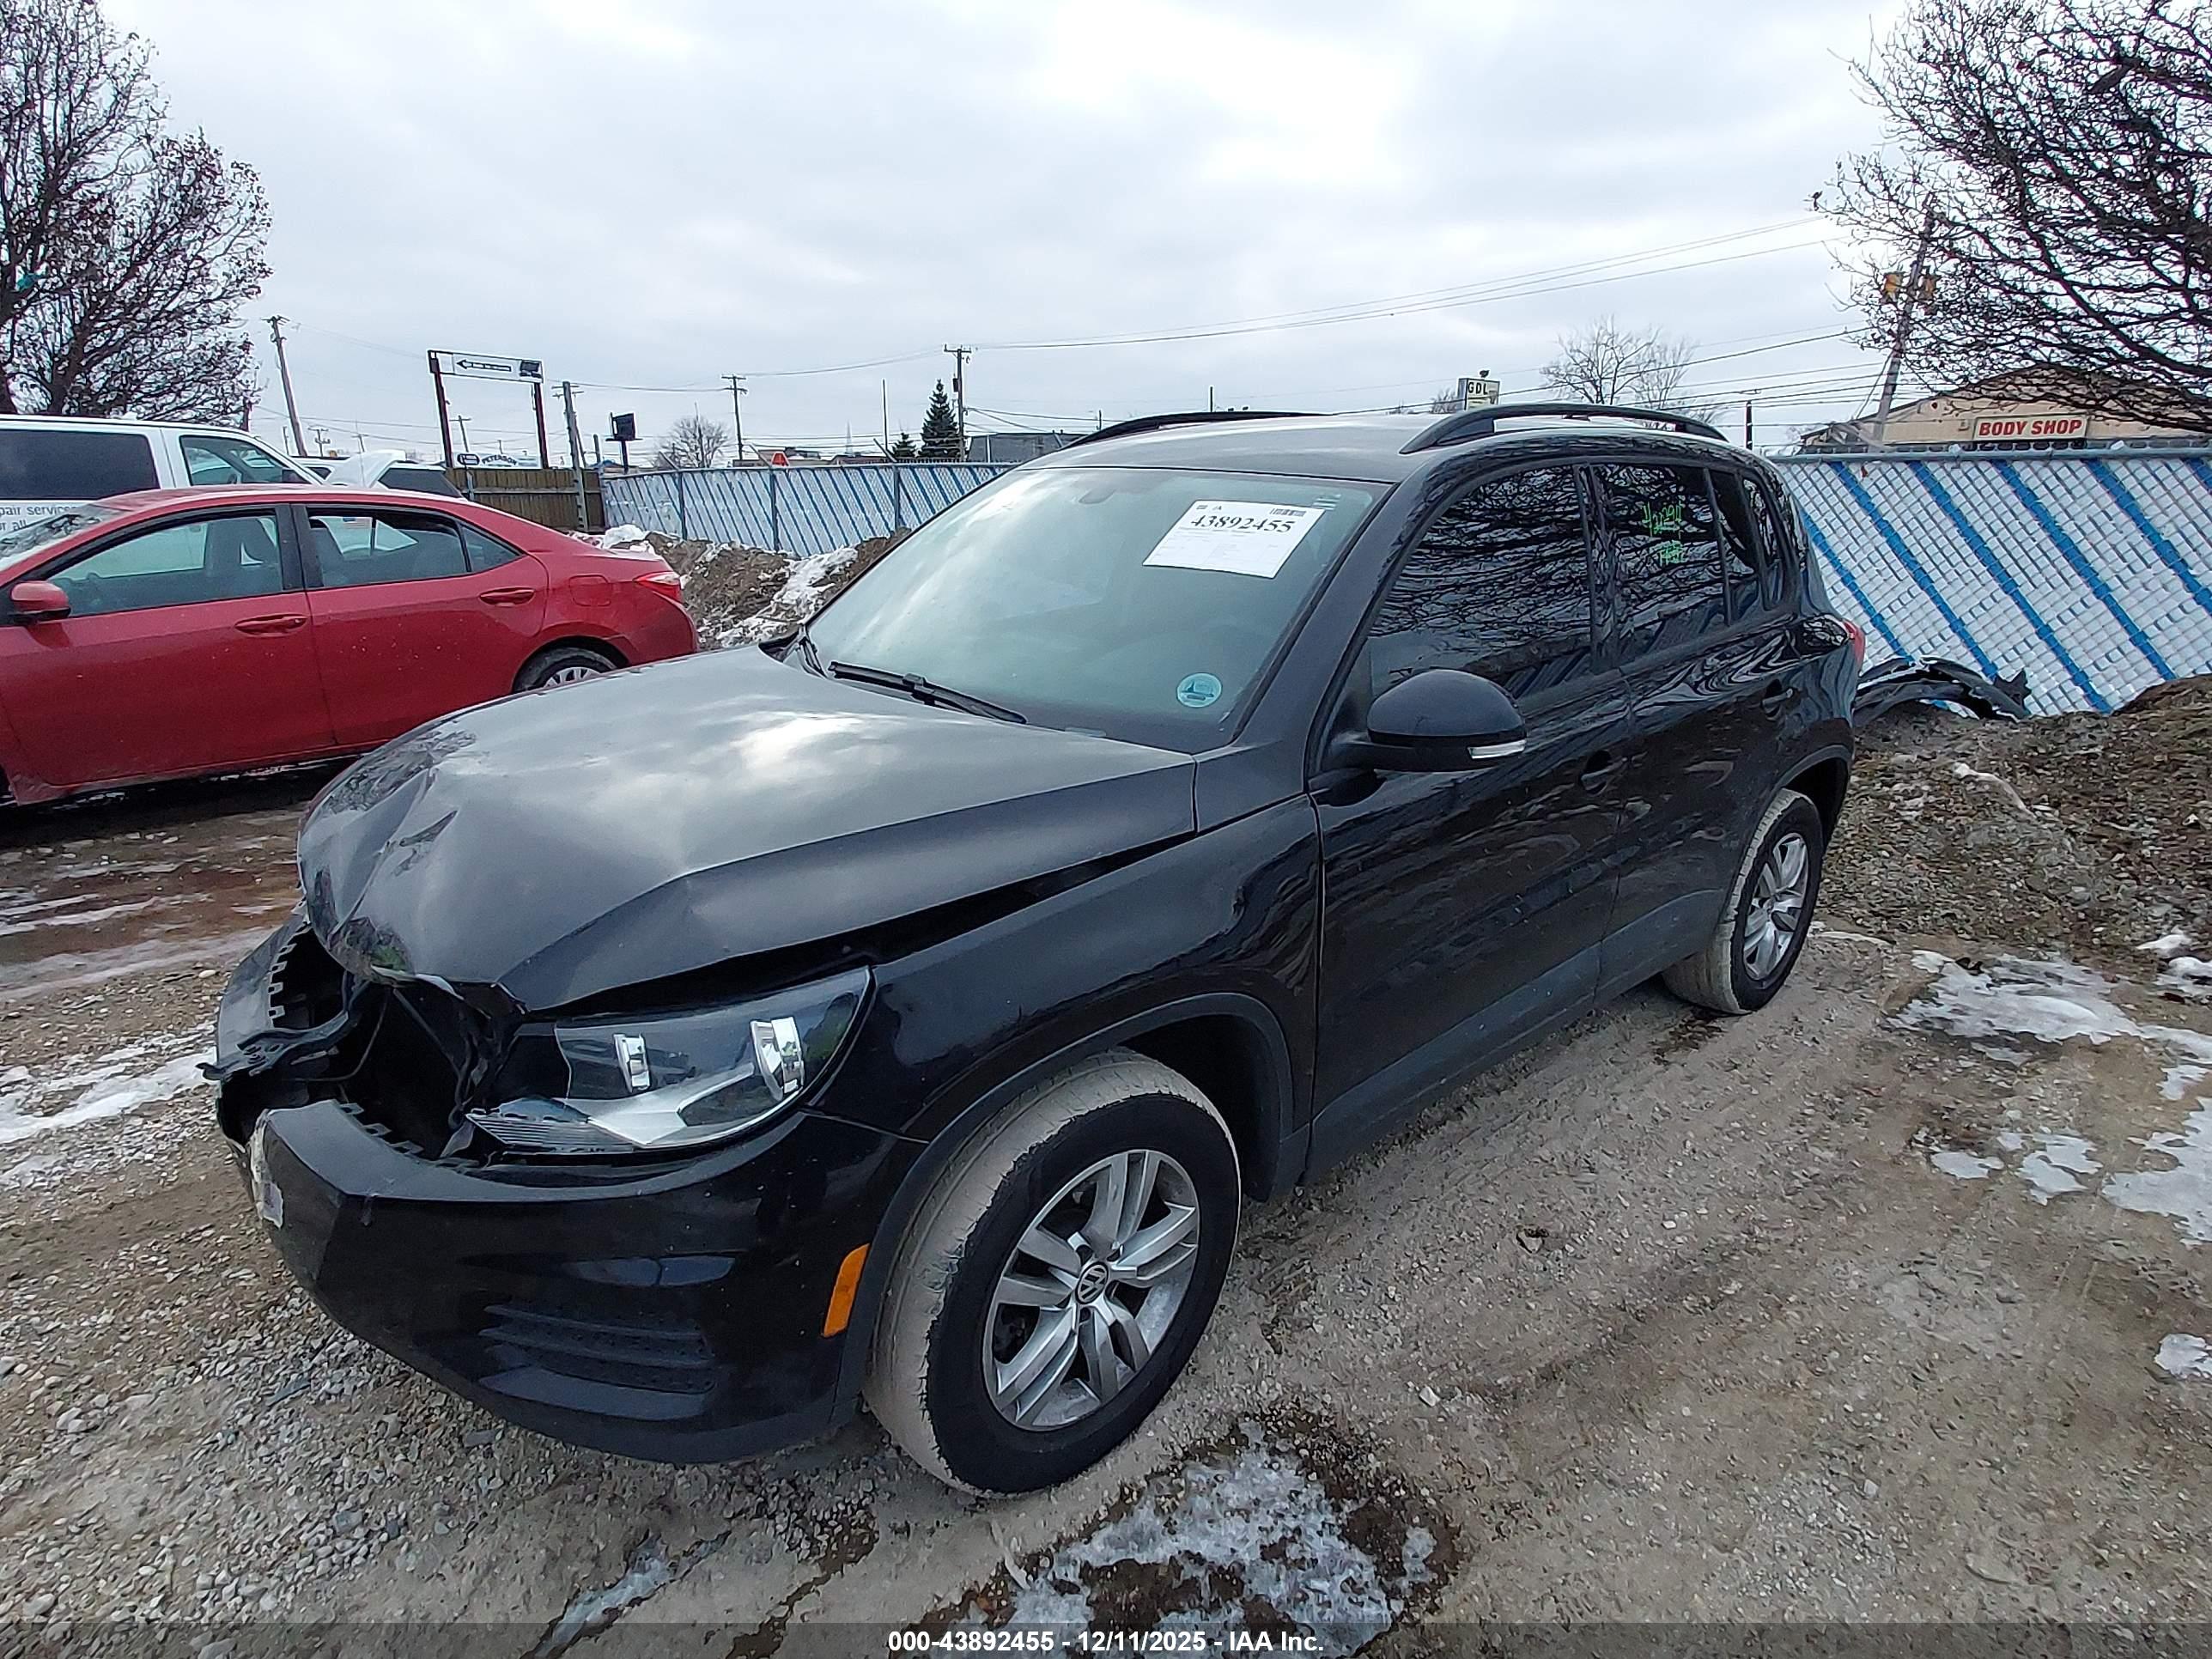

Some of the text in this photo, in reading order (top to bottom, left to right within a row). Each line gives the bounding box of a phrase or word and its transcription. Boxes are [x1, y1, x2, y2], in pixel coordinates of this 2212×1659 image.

[1468, 381, 1488, 395] GDL
[1978, 419, 2082, 436] BODY SHOP
[1191, 514, 1296, 533] 43892455
